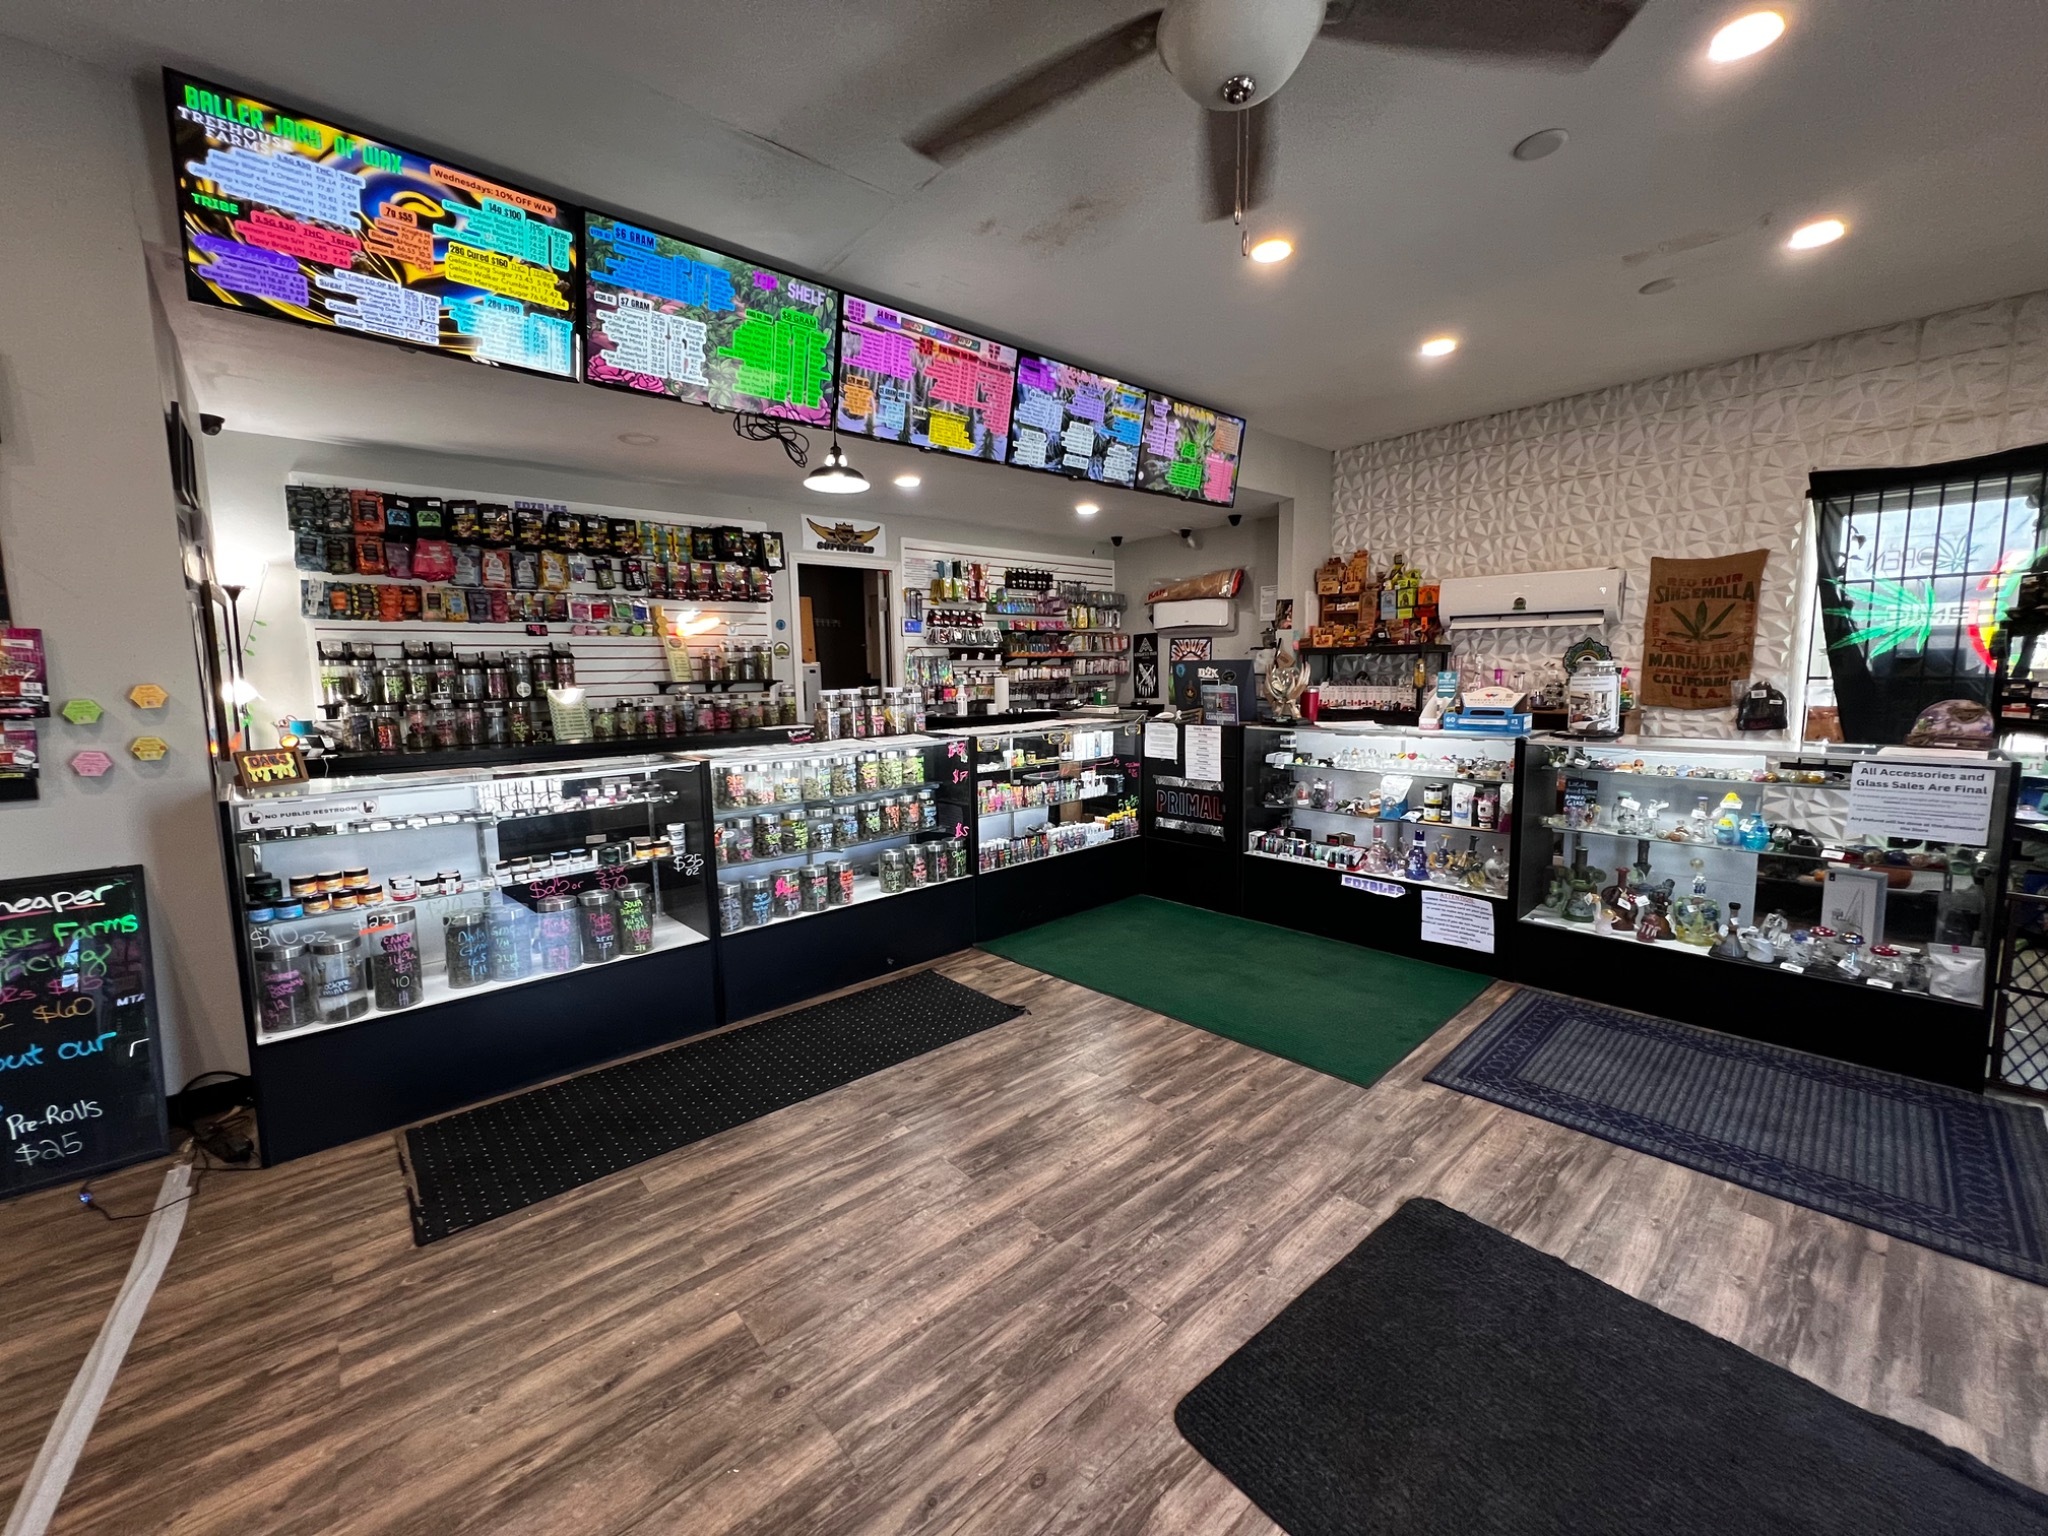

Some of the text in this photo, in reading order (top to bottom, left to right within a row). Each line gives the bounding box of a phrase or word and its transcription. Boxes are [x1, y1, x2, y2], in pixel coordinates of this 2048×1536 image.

[177, 105, 294, 152] TREEHOUSE
[184, 84, 403, 175] BALLER JARS OF WAX
[205, 125, 270, 156] FARMS
[433, 168, 555, 215] Wednesdays: 10% OFF WAX
[190, 192, 239, 215] TRIBE
[504, 206, 522, 220] $100
[615, 227, 627, 240] $6
[629, 230, 655, 247] GRAM
[466, 248, 489, 264] Cured
[491, 255, 509, 269] $160
[473, 261, 492, 277] King
[319, 279, 342, 291] Sugar
[787, 282, 826, 307] SHELF
[620, 296, 630, 307] $7
[630, 299, 650, 311] GRAM
[793, 314, 817, 327] GRAM
[1701, 573, 1745, 588] HAIR
[1653, 580, 1756, 605] SINSEMILLA
[1648, 651, 1752, 671] MARIJUANA
[1652, 673, 1740, 688] CALIFORNIA
[1671, 685, 1724, 700] U.S.A.
[952, 768, 969, 785] $7
[1860, 767, 1985, 782] All Accessories and
[1856, 779, 1988, 795] Glass Sales Are Final
[264, 805, 359, 820] NO PUBLIC RESTROOM
[1155, 789, 1223, 821] PRIMAL
[608, 864, 630, 877] for
[673, 853, 705, 872] $35
[571, 880, 585, 891] or
[599, 874, 629, 892] $70
[1343, 876, 1406, 898] EDIBLES
[52, 913, 139, 948] Farms
[249, 926, 299, 950] $10
[57, 1031, 118, 1061] our
[5, 1099, 104, 1141] Pre-Rolls
[14, 1130, 84, 1168] $25
